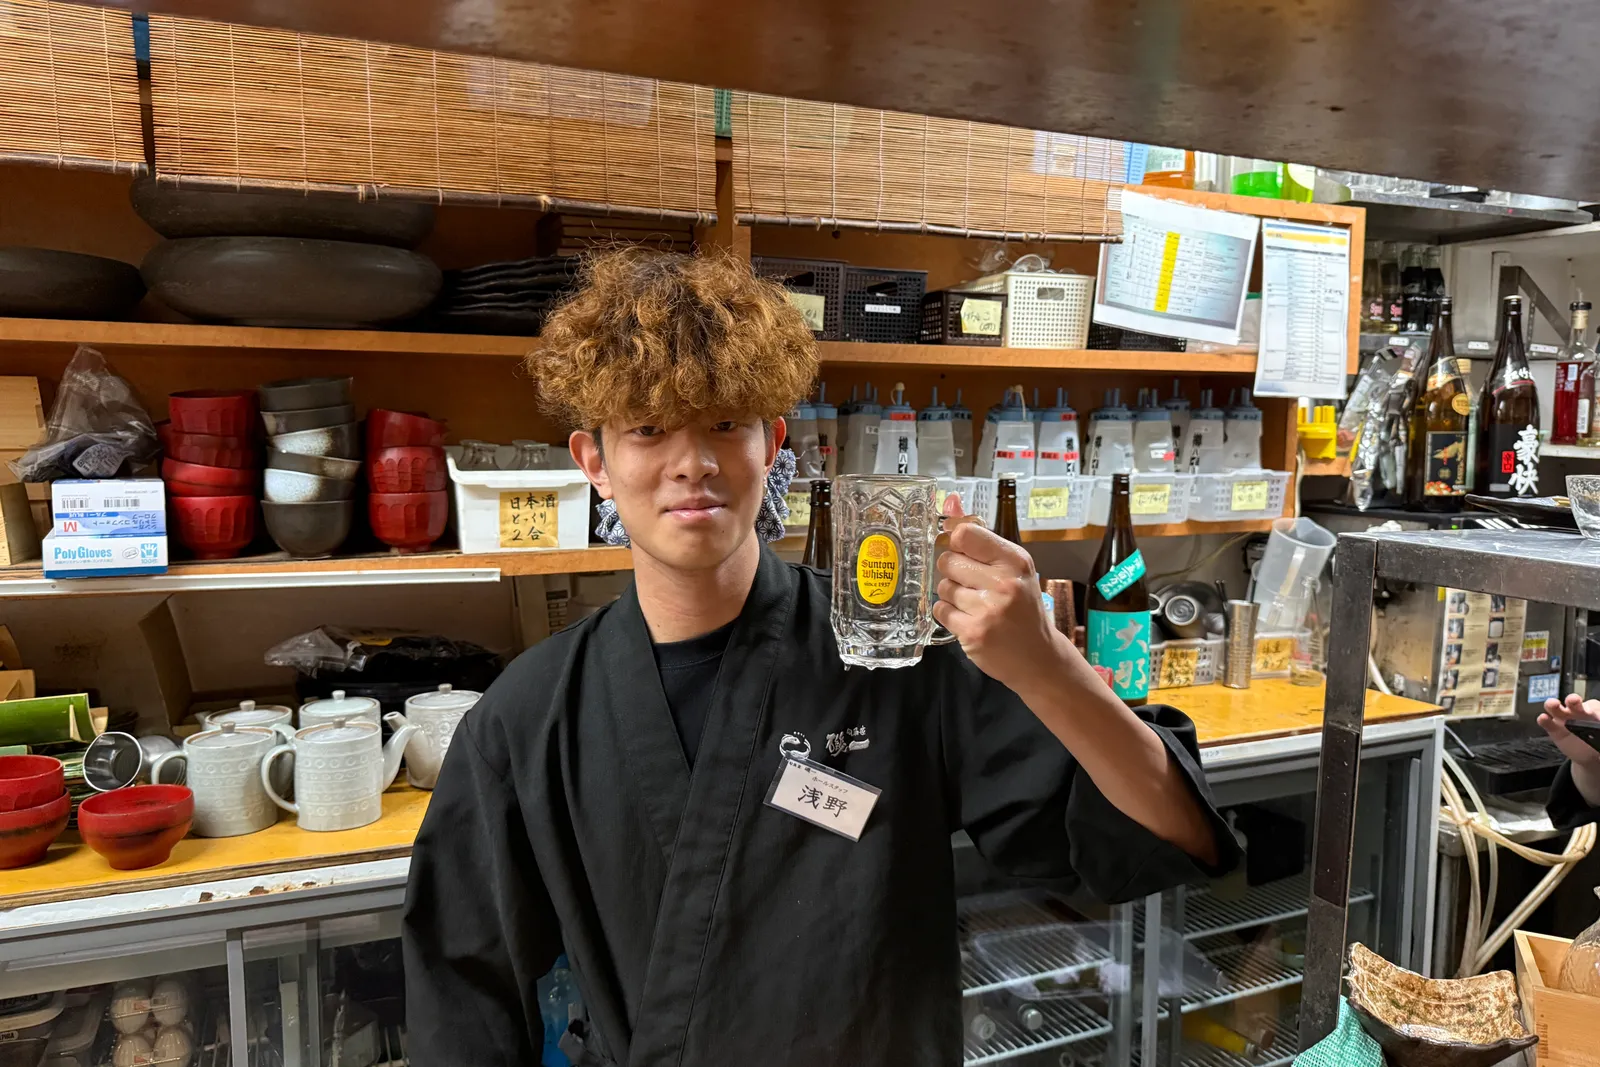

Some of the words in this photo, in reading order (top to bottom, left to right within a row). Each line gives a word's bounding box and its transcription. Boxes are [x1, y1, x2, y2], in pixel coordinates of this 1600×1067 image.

[1508, 424, 1540, 495] 豪快
[510, 492, 555, 510] 日本酒
[512, 511, 546, 525] とっくり
[63, 521, 78, 532] M
[861, 559, 895, 571] Suntory
[862, 569, 893, 581] Whisky
[1112, 618, 1147, 690] 大那
[797, 785, 848, 818] 浅野
